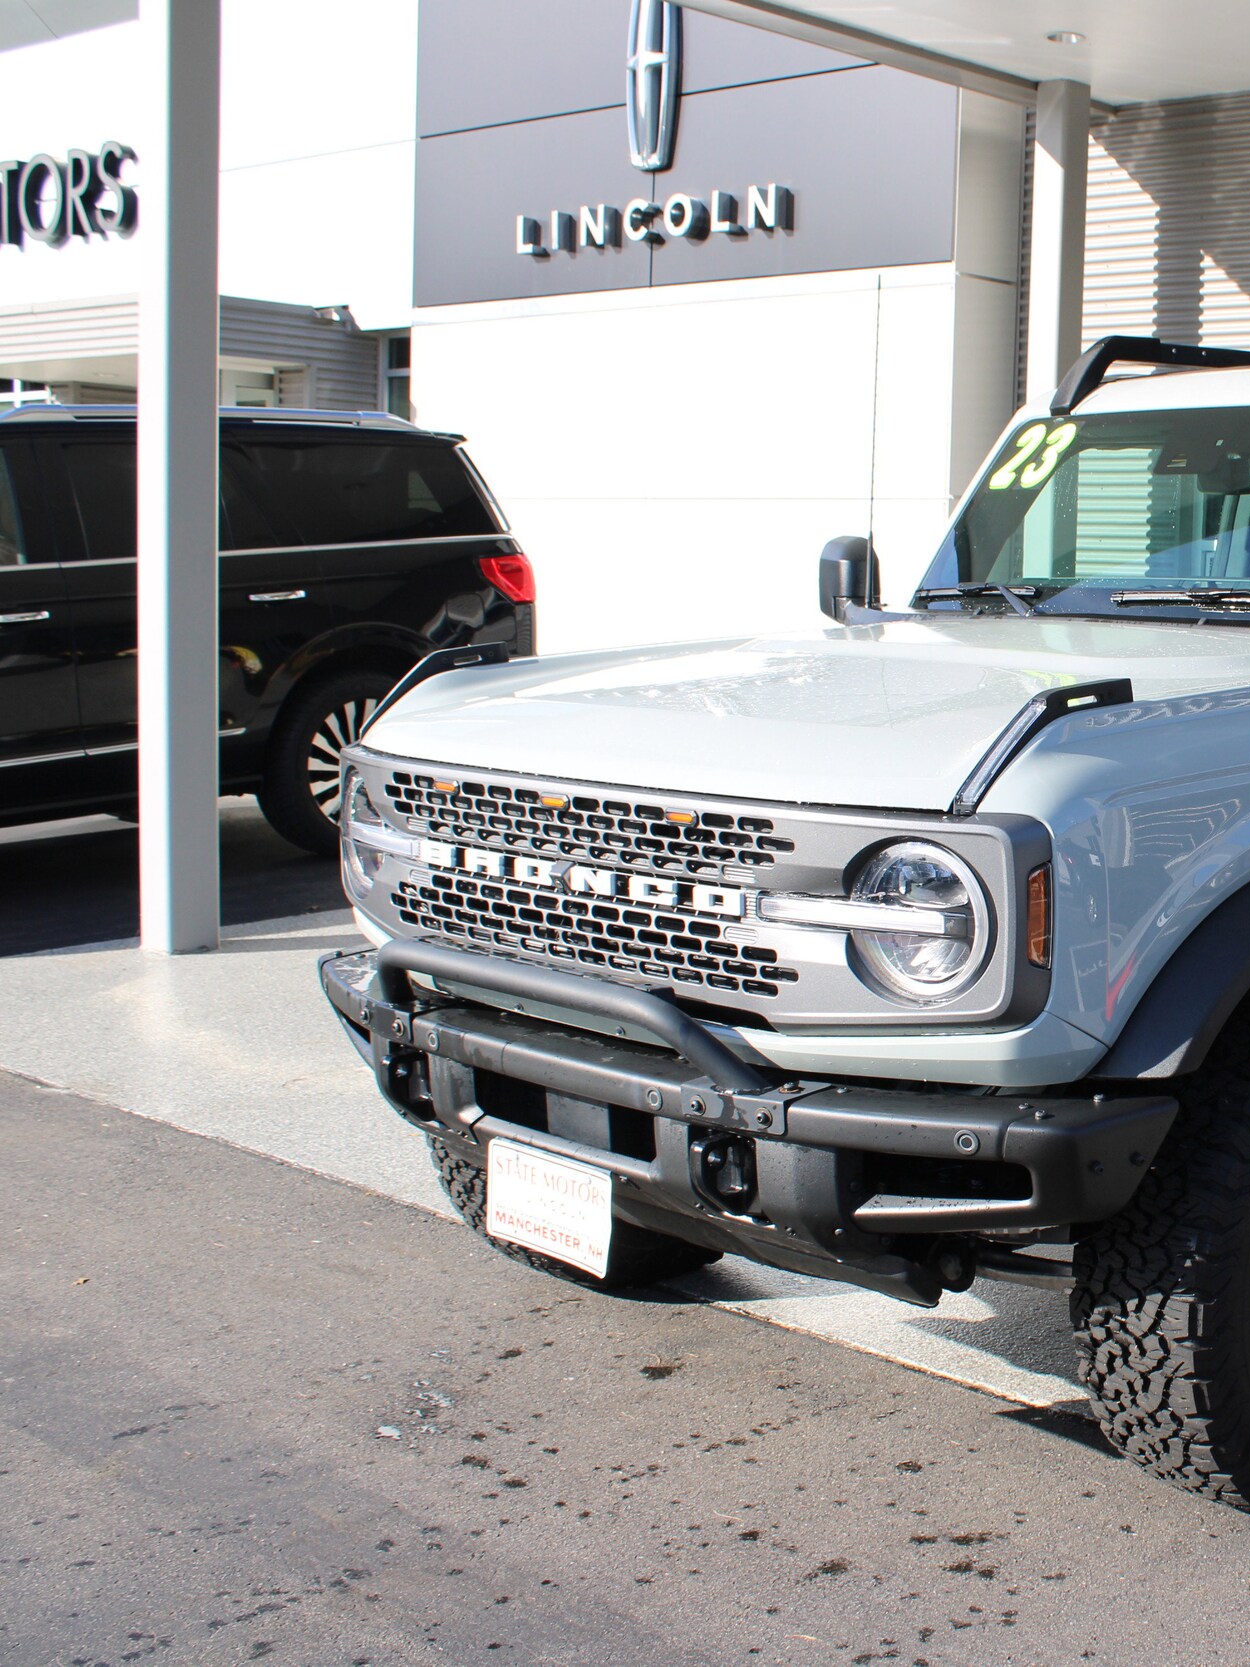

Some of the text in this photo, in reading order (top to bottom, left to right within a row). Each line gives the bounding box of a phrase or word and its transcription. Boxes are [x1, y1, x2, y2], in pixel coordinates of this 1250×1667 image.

[515, 182, 795, 257] LINCOLN
[988, 422, 1077, 490] 23
[420, 838, 746, 917] BRONCO
[495, 1155, 608, 1208] STATE MOTORS
[587, 1242, 604, 1261] NH
